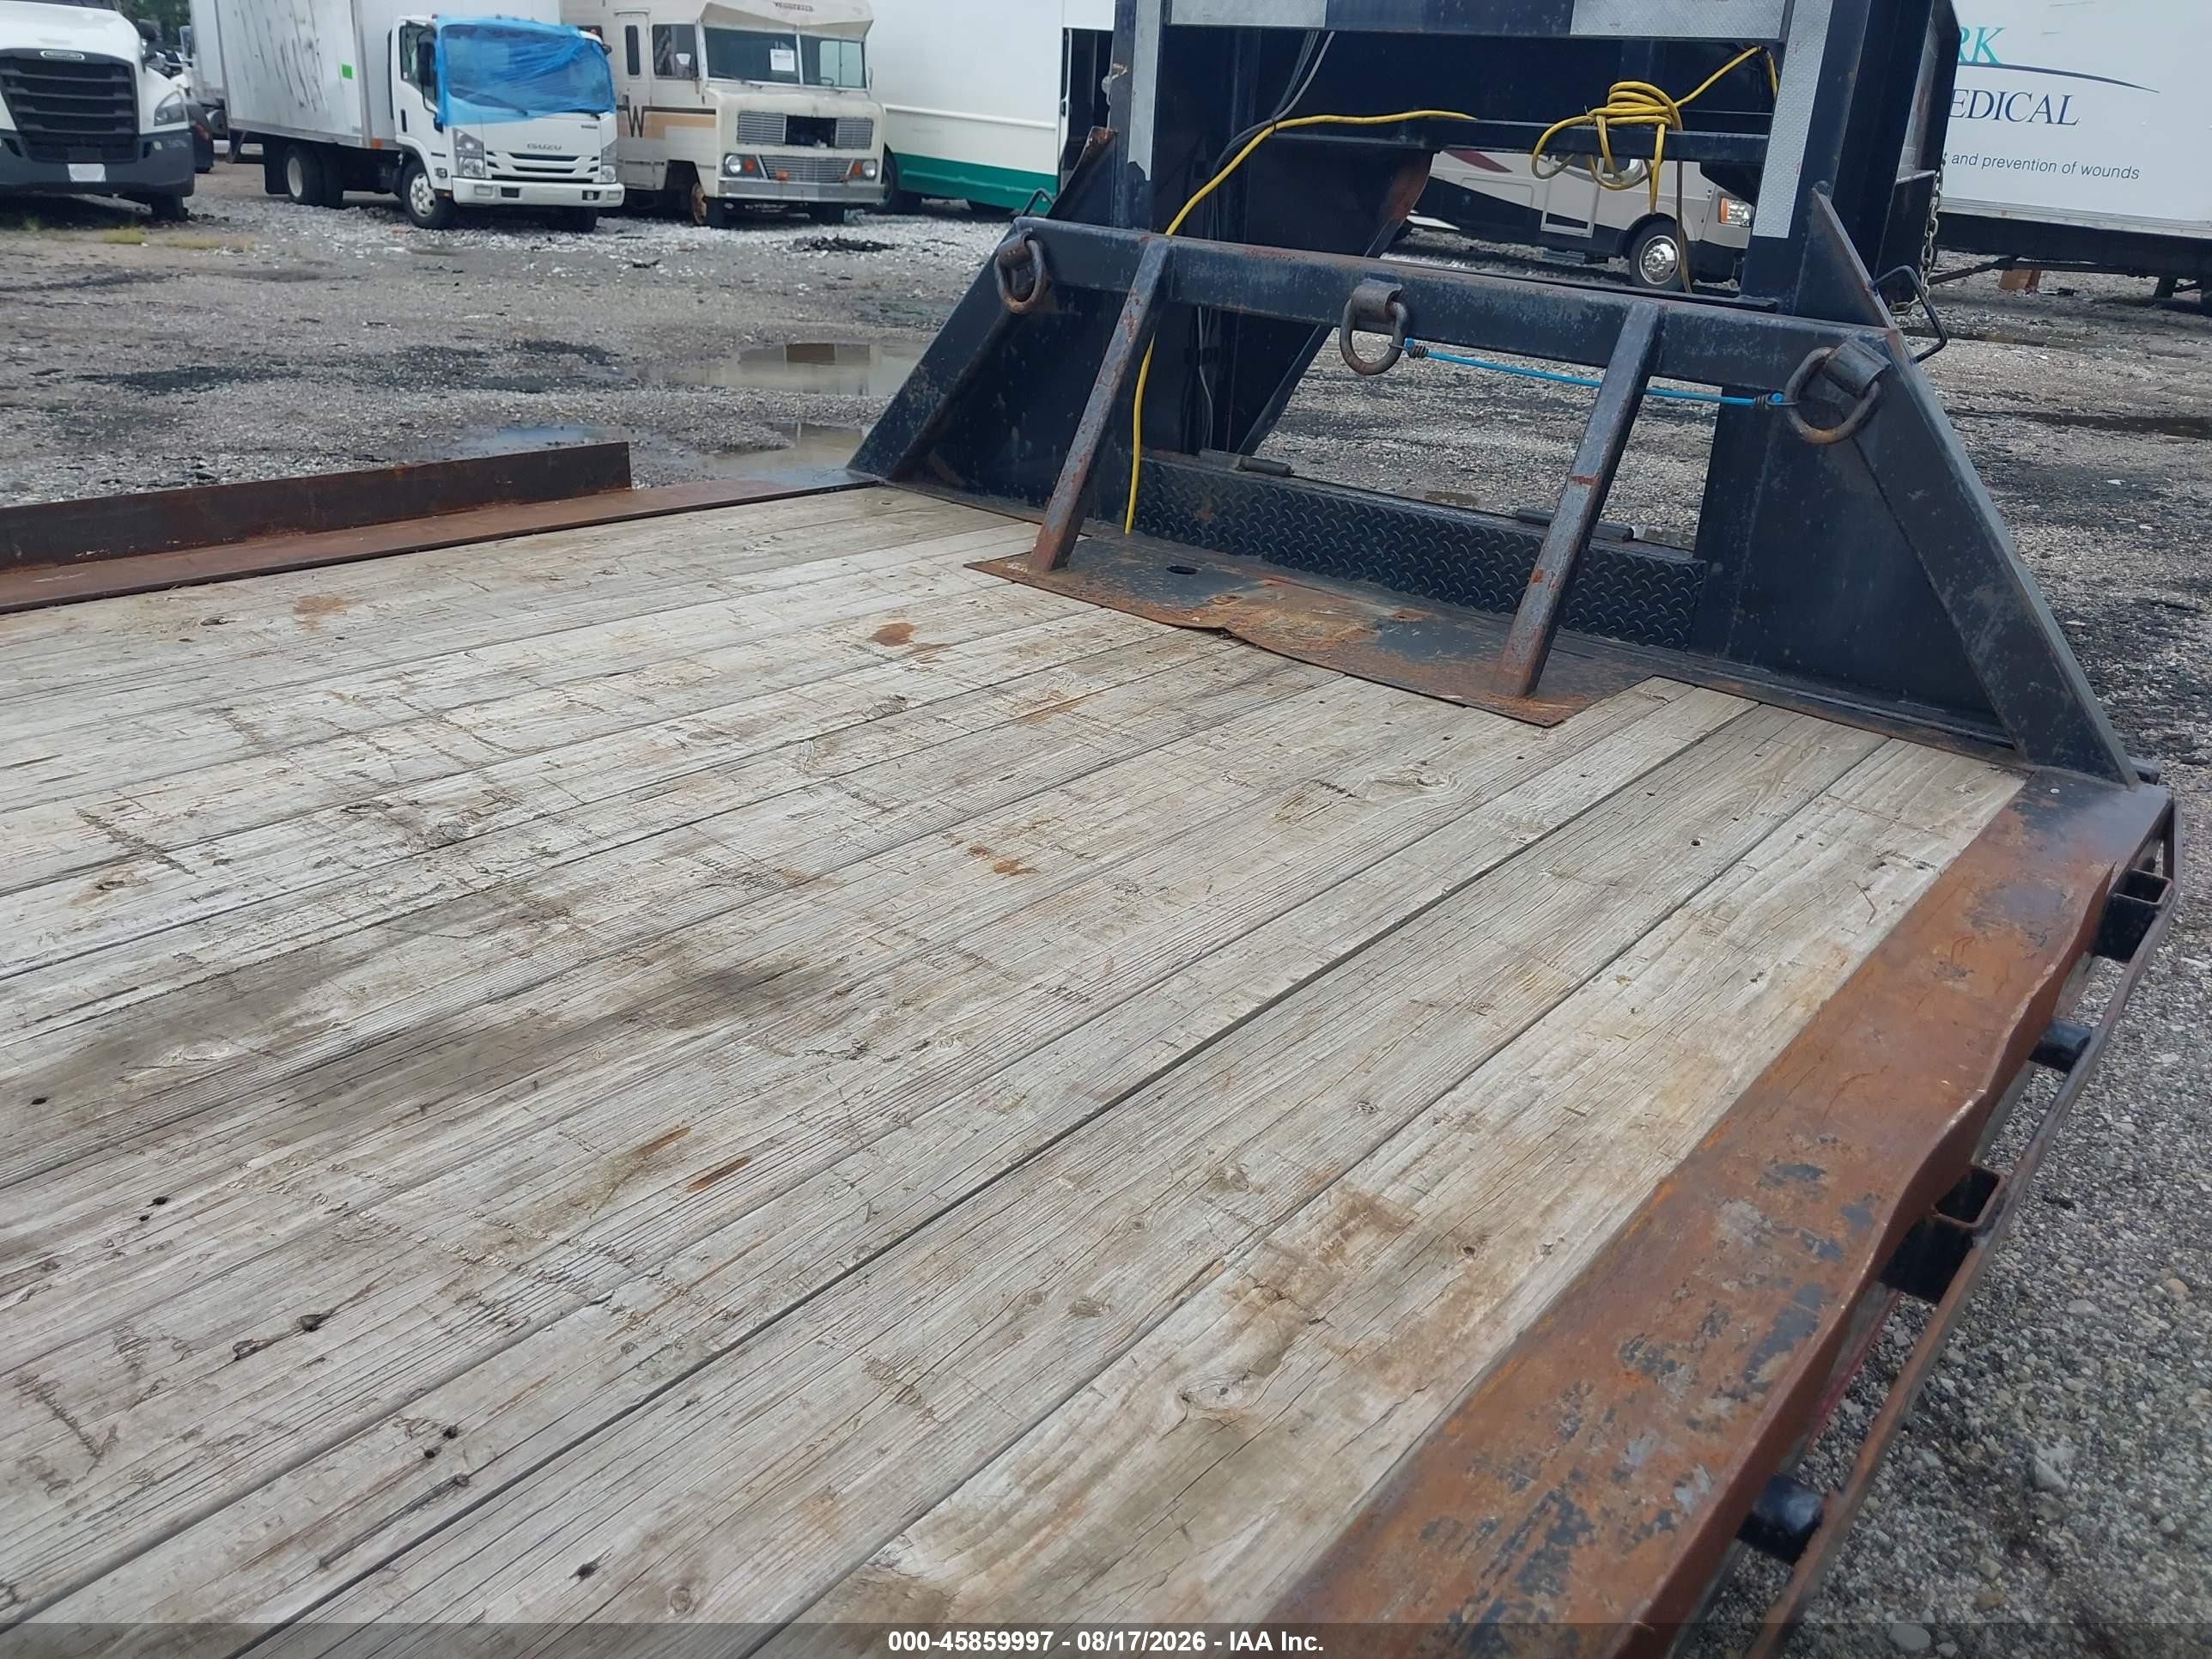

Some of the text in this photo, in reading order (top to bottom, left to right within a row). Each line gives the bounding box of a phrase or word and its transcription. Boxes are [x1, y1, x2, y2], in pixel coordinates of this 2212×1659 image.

[1951, 153, 1979, 166] and
[1981, 155, 2057, 173] prevention
[2061, 161, 2078, 174] of
[2080, 165, 2141, 179] wounds
